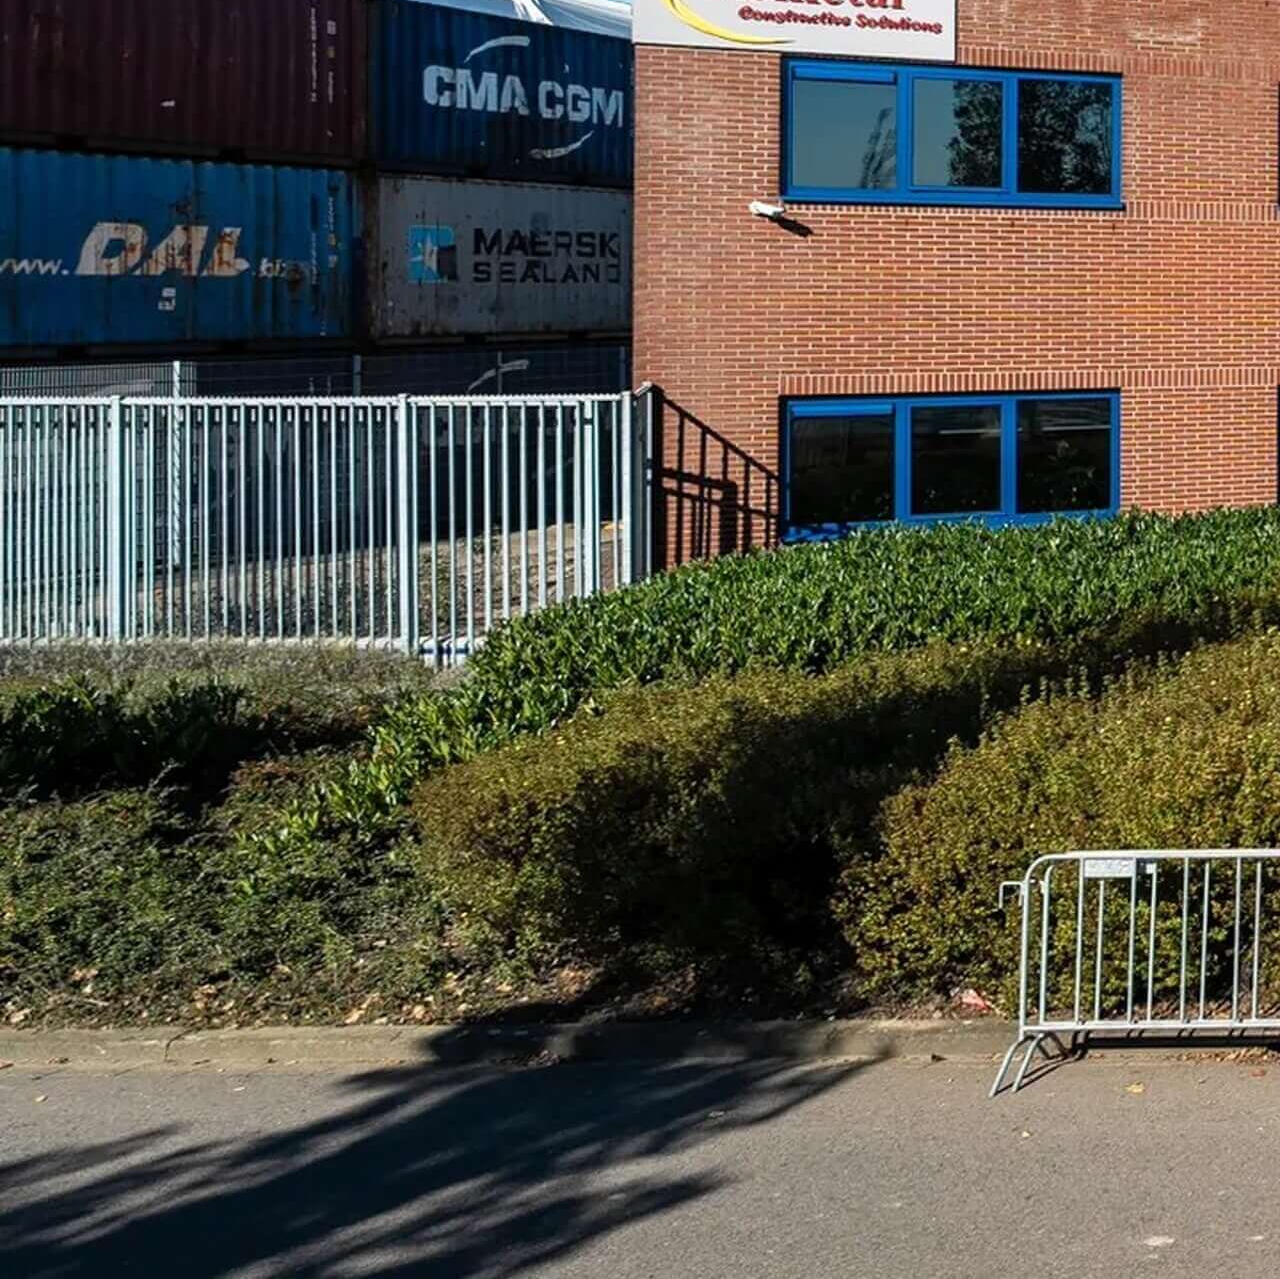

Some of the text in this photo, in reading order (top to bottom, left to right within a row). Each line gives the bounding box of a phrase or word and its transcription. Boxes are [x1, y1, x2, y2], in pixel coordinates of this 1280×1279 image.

[737, 5, 944, 35] Constructive Solutions
[422, 64, 625, 128] CMA CGM
[472, 227, 621, 259] MAERSK
